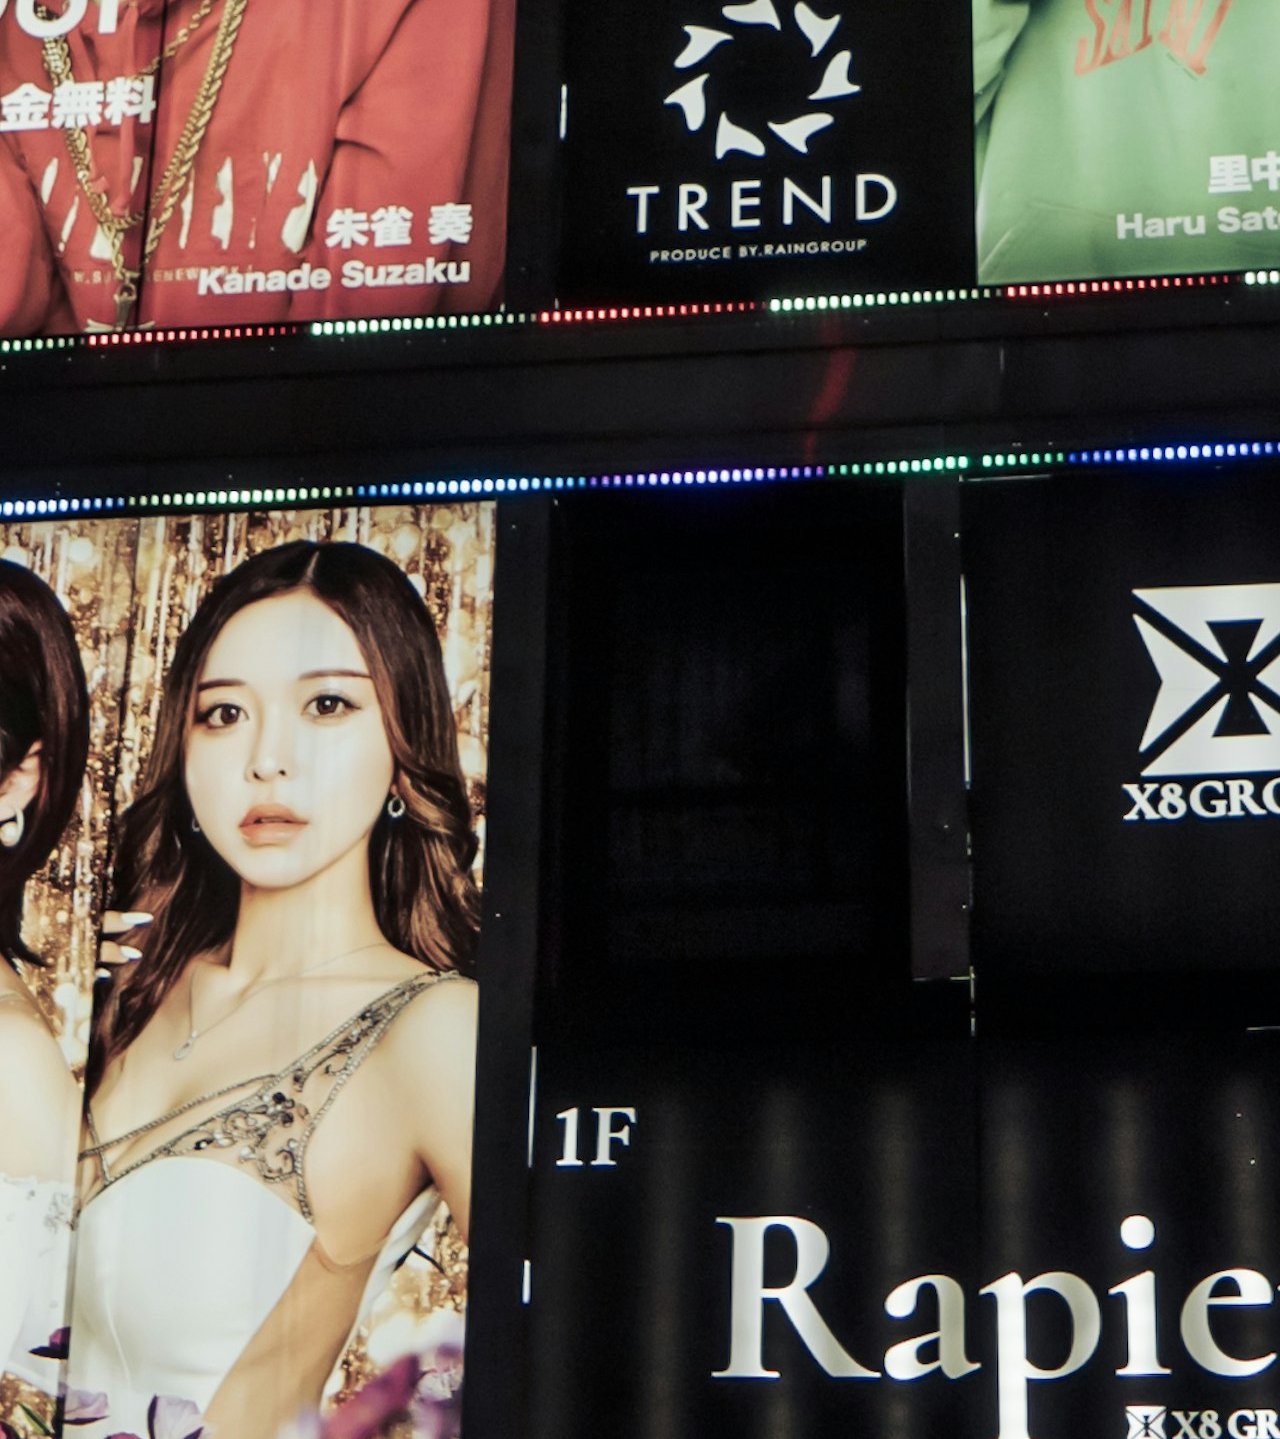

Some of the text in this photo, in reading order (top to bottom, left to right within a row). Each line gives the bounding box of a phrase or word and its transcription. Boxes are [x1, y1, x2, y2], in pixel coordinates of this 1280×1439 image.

[626, 173, 899, 235] TREND
[1117, 208, 1207, 240] Haru
[649, 245, 731, 263] PRODUCE
[197, 263, 331, 296] Kanade
[340, 256, 471, 288] Suzaku
[555, 1106, 638, 1167] 1F
